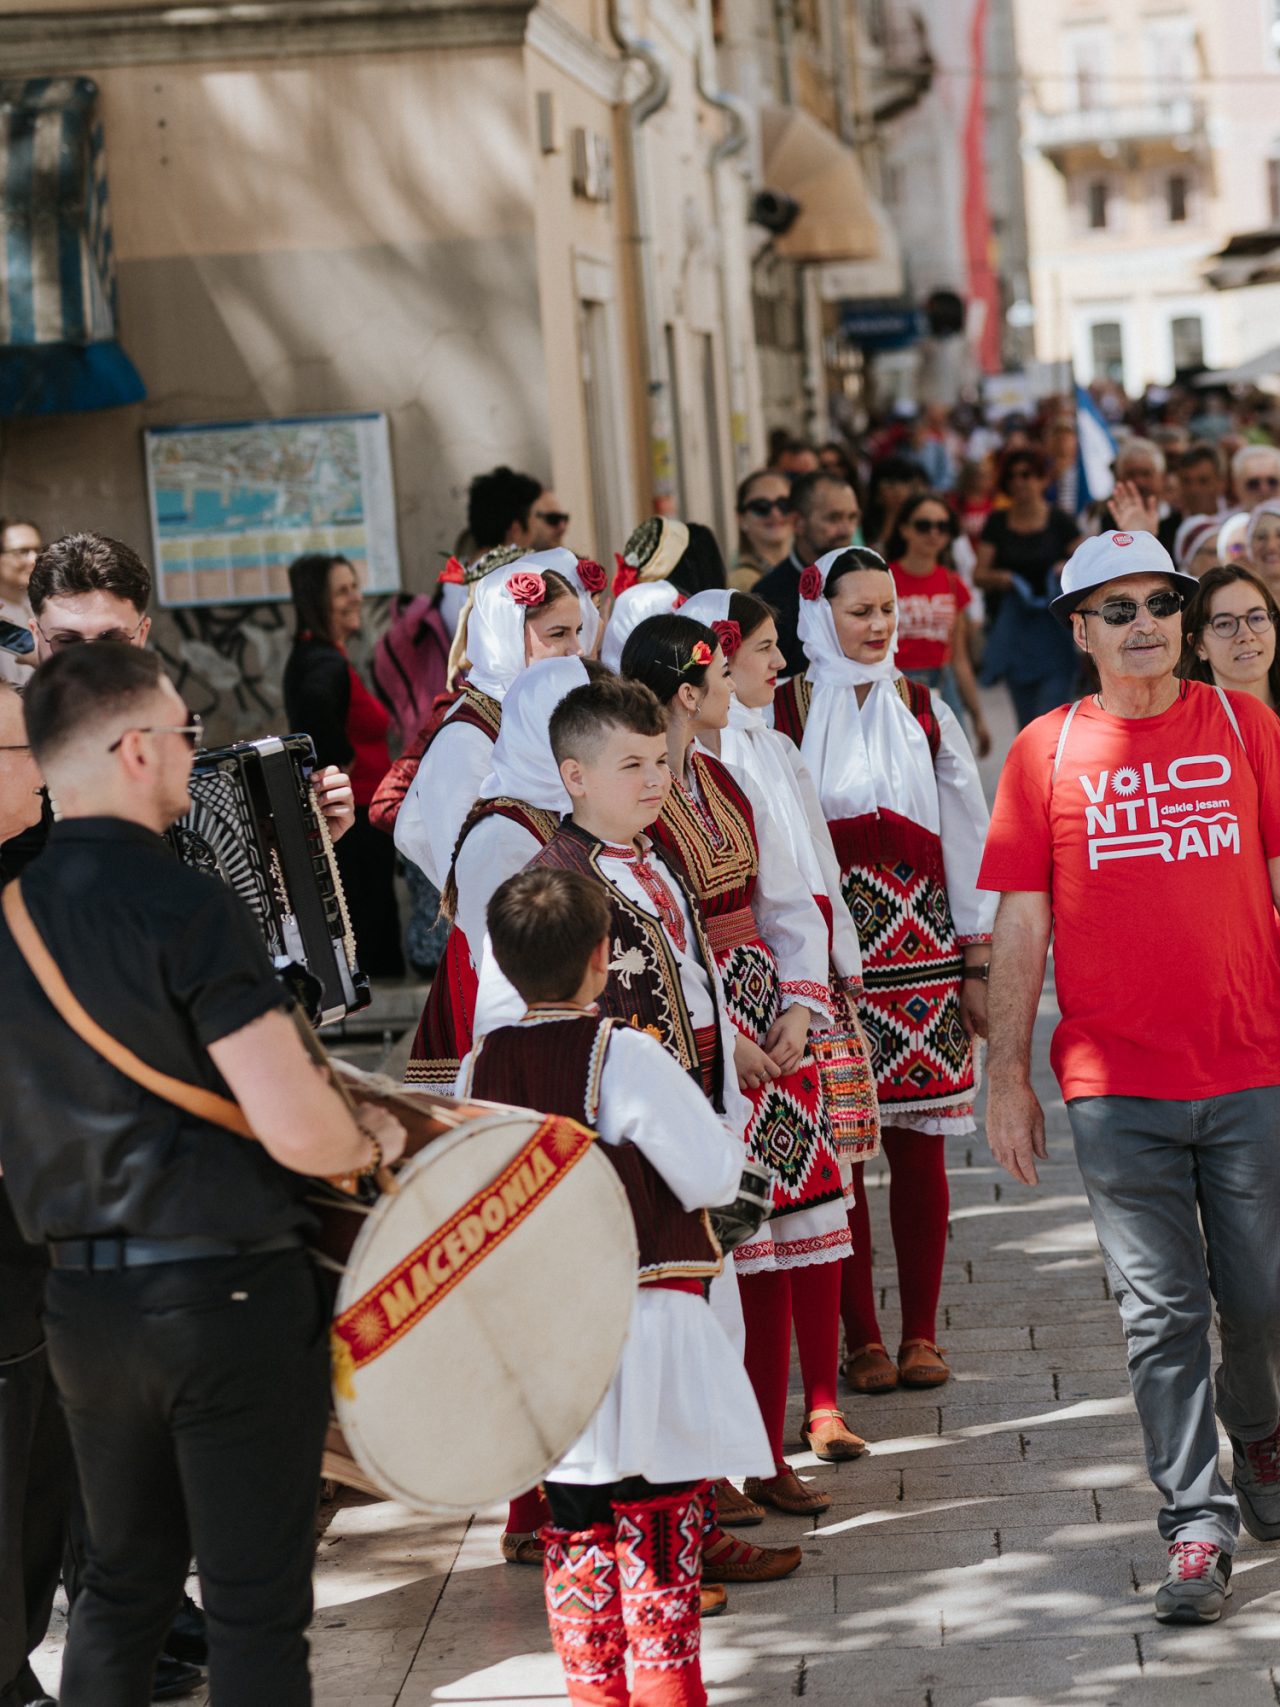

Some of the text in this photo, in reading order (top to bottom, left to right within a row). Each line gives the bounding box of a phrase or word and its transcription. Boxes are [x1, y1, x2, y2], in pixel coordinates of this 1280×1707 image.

[1078, 753, 1232, 804] VOLO
[1085, 796, 1160, 836] NTI
[1195, 799, 1231, 812] jesam
[1088, 822, 1241, 871] RAM
[378, 1145, 558, 1330] MACEDONIA
